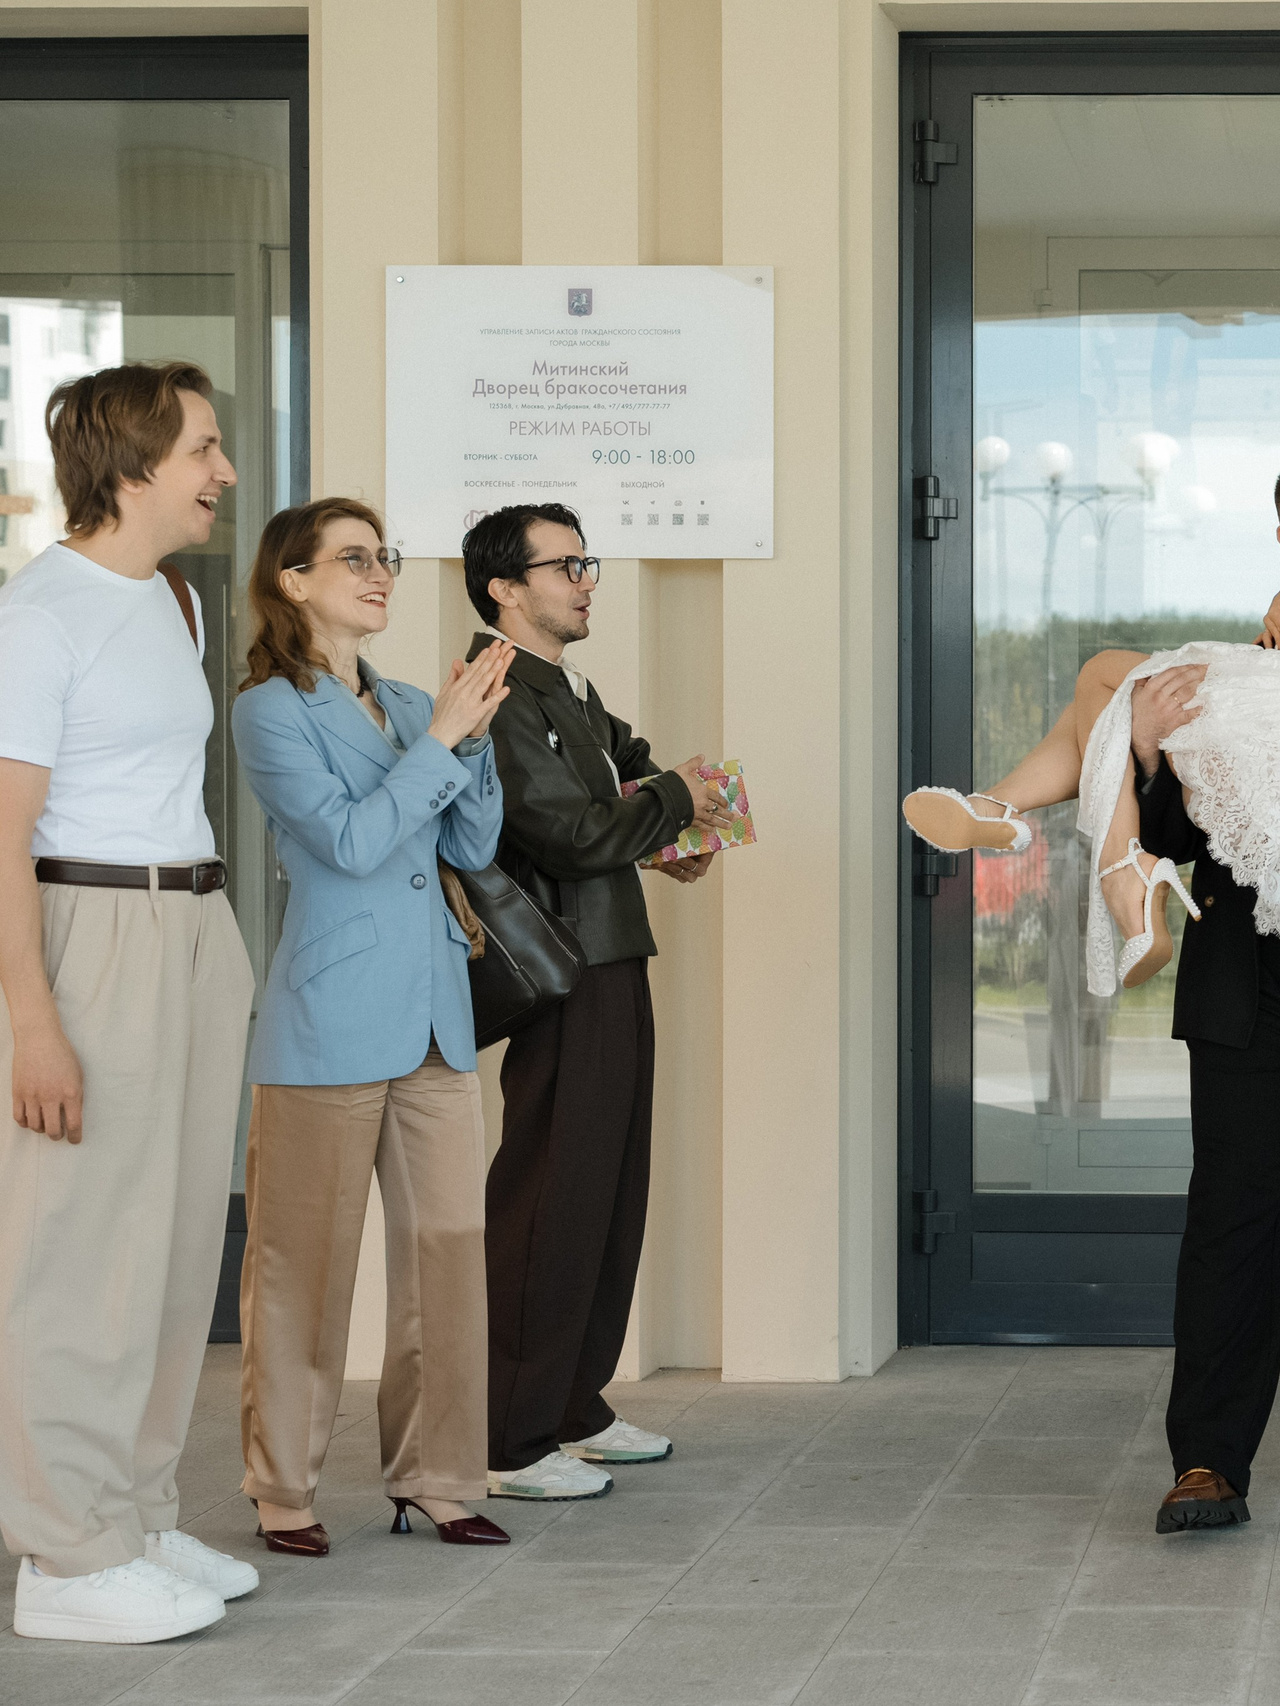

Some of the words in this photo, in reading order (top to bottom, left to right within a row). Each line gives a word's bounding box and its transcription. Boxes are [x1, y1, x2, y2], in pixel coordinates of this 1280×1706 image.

[479, 328, 524, 336] УПРАВЛЕНИЕ
[525, 328, 555, 336] ЗАПИСИ
[556, 328, 579, 336] АКТОВ
[581, 328, 637, 337] ГРАЖДАНСКОГО
[638, 328, 682, 336] СОСТОЯНИЯ
[549, 339, 578, 347] ГОРОДА
[579, 339, 611, 347] МОСКВЫ
[531, 360, 629, 376] Митинский
[472, 378, 540, 399] Дворец
[544, 377, 688, 399] бракосочетания
[509, 420, 576, 436] РЕЖИМ
[581, 420, 651, 436] РАБОТЫ
[463, 453, 498, 461] ВТОРНИК
[504, 453, 539, 461] СУББОТА
[591, 449, 631, 465] 9:00
[649, 449, 696, 465] 18:00
[463, 480, 516, 488] ВОСКРЕСЕНЬЕ
[521, 480, 578, 488] ПОНЕДЕЛЬНИК
[620, 480, 666, 489] ВЫХОДНОЙ
